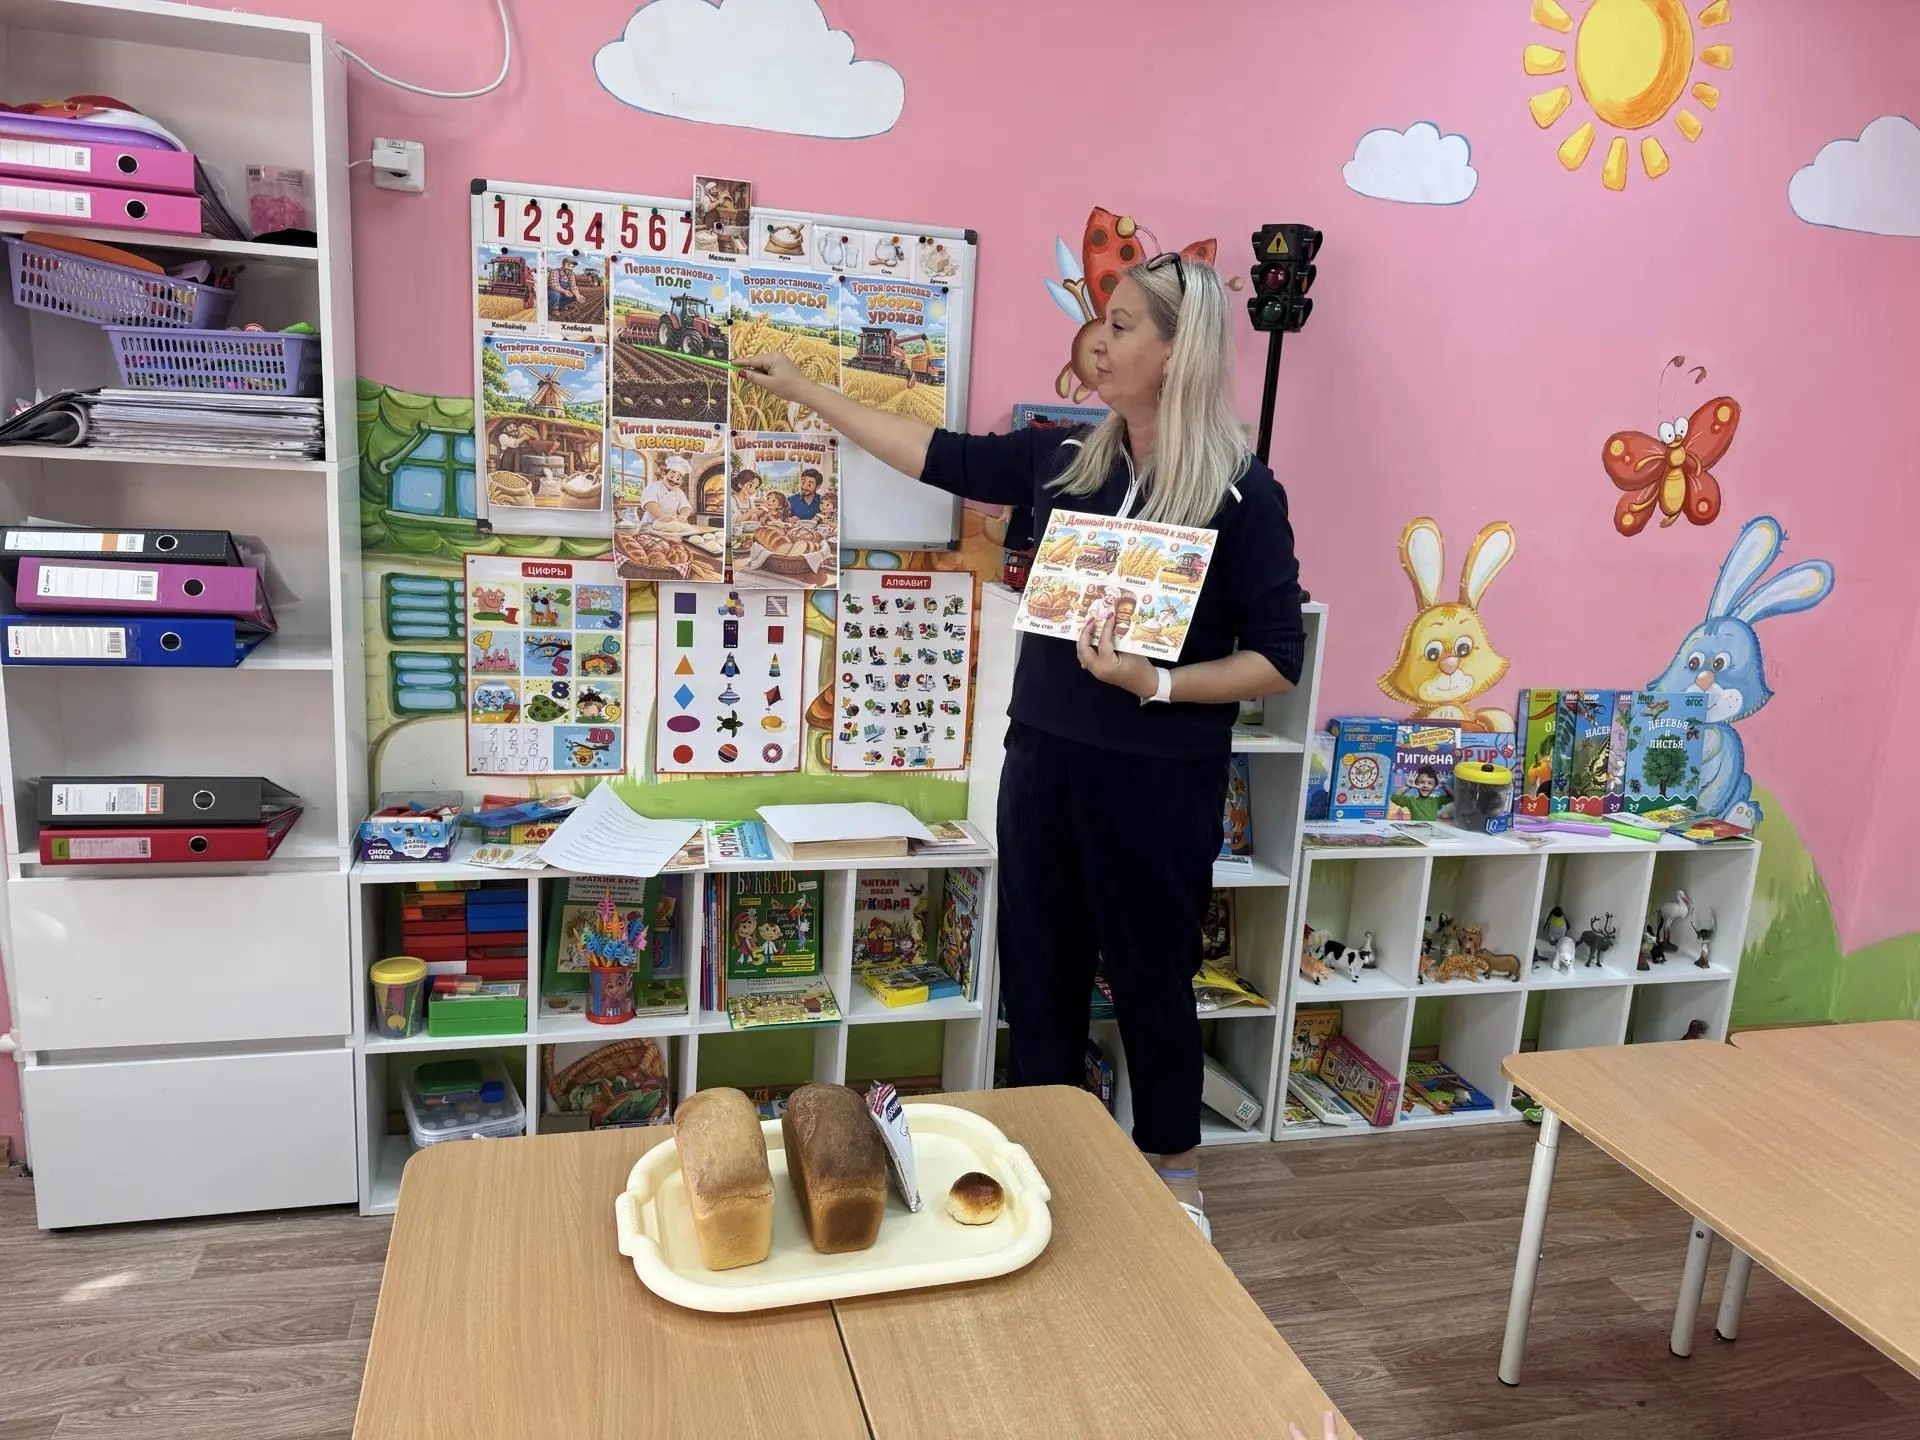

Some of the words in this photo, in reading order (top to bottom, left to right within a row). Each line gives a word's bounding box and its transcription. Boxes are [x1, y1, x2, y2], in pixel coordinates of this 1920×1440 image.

[494, 199, 505, 237] 1
[524, 203, 542, 242] 2
[557, 207, 574, 245] 3
[585, 212, 604, 250] 4
[620, 211, 638, 249] 5
[648, 214, 666, 251] 6
[680, 216, 693, 254] 7
[708, 253, 737, 264] Мельник
[624, 263, 662, 276] Первая
[664, 266, 714, 282] остановка
[743, 275, 776, 287] Вторая
[778, 278, 823, 291] остановка
[851, 281, 883, 294] Третья
[885, 284, 931, 298] остановка
[867, 294, 923, 312] уборка
[867, 310, 925, 326] урожая
[491, 321, 527, 331] Комбайнёр
[561, 323, 593, 333] Хлебороб
[496, 343, 540, 353] Четвёртая
[542, 345, 584, 358] остановка
[619, 421, 654, 436] Пятая
[655, 423, 712, 439] остановка
[634, 435, 705, 453] пекарня
[733, 435, 774, 450] Шестая
[775, 439, 827, 453] остановка
[754, 450, 786, 463] наш
[788, 451, 821, 465] стол
[1065, 514, 1105, 527] Длинный
[1105, 517, 1123, 531] путь
[1124, 522, 1132, 530] от
[1133, 521, 1169, 537] зёрнышка
[1169, 528, 1176, 538] к
[1176, 528, 1200, 544] хлебу
[528, 566, 567, 576] ЦИФРЫ
[886, 578, 928, 587] АЛФАВИТ
[553, 588, 571, 607] 2
[843, 593, 851, 604] А
[872, 595, 880, 606] Б
[895, 598, 904, 608] В
[504, 607, 520, 624] 1
[603, 611, 622, 629] 3
[844, 622, 851, 632] Е
[944, 622, 954, 633] И
[1029, 620, 1041, 629] Наш
[869, 625, 876, 638] Ё
[473, 631, 493, 650] 4
[602, 635, 621, 654] 6
[869, 646, 878, 657] К
[918, 648, 928, 659] М
[1141, 643, 1169, 654] Мельница
[551, 656, 570, 676] 5
[865, 674, 873, 684] П
[916, 674, 924, 685] С
[943, 674, 951, 684] Т
[552, 681, 570, 699] 8
[1535, 691, 1552, 701] МИР
[1566, 692, 1578, 702] МИ
[1584, 693, 1600, 702] МИР
[1619, 694, 1632, 703] МИ
[1637, 694, 1655, 703] МИР
[890, 702, 899, 713] Х
[1685, 697, 1704, 707] ФГОС
[503, 704, 520, 723] 7
[604, 704, 622, 723] 9
[940, 703, 949, 713] Ч
[914, 722, 927, 734] Ы
[1647, 718, 1690, 732] ДЕРЕВЬЯ
[508, 728, 518, 742] 2
[528, 728, 538, 742] 3
[587, 728, 615, 744] 10
[839, 732, 851, 741] Ш
[1649, 739, 1684, 749] ЛИСТЬЯ
[489, 743, 498, 756] 4
[508, 744, 518, 757] 5
[528, 743, 538, 757] 6
[518, 757, 528, 771] 9
[891, 756, 905, 767] Ю
[618, 877, 641, 885] КУРС
[736, 870, 796, 895] БУКВАРЬ
[861, 879, 899, 887] ЧИТАЕМ
[855, 898, 911, 911] БУКВАРЯ
